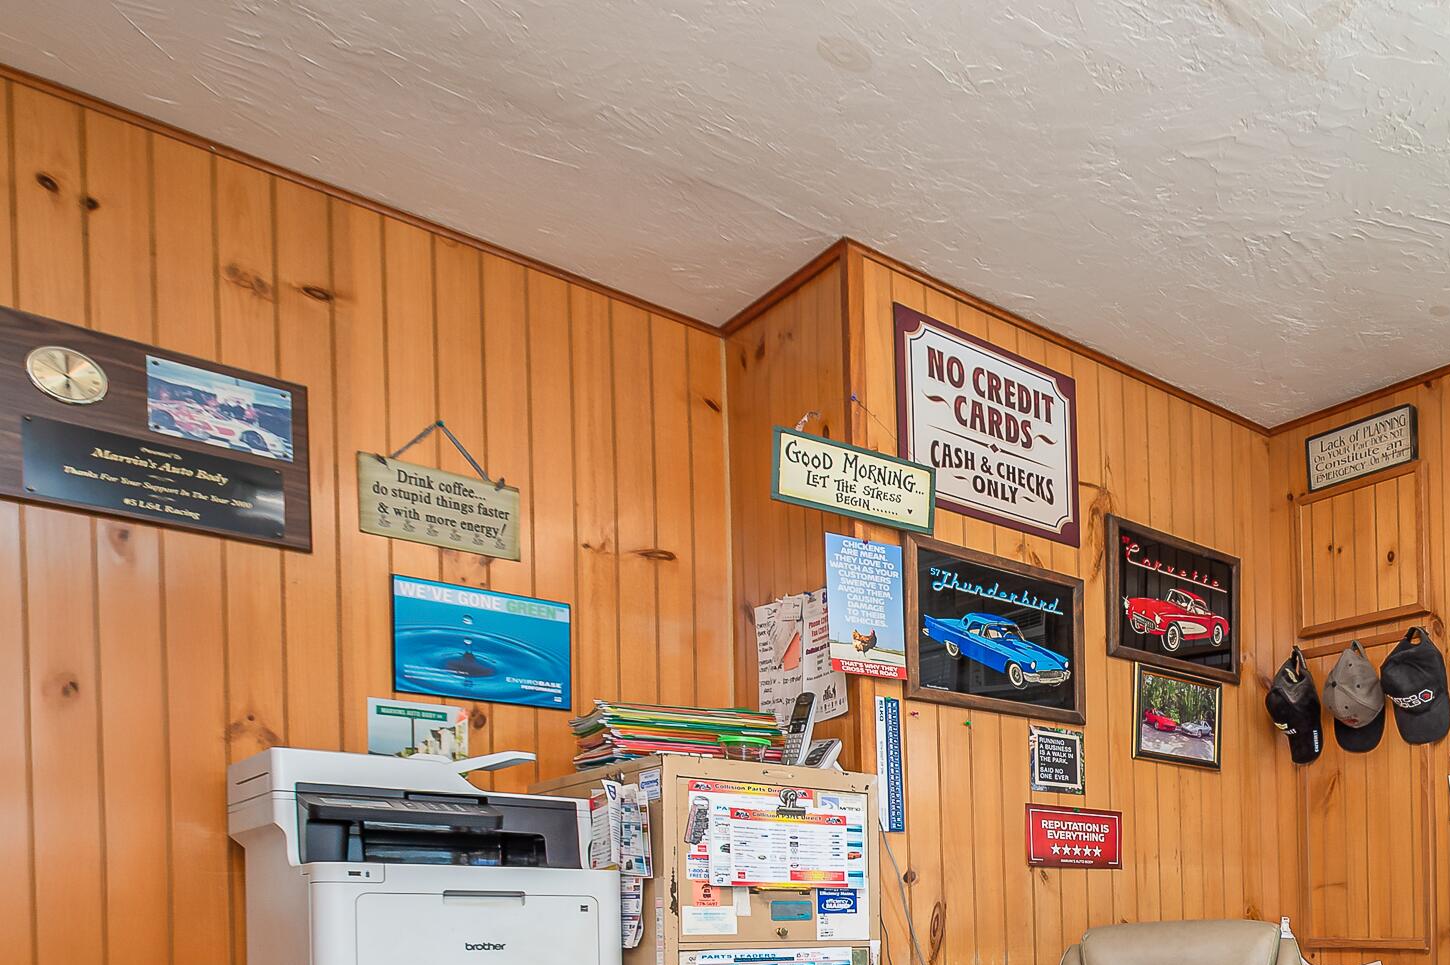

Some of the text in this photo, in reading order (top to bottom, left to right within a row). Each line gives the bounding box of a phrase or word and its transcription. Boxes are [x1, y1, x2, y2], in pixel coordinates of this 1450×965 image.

[926, 346, 1055, 424] NO CREDIT
[954, 396, 1033, 449] CARDS
[1320, 414, 1406, 453] Lack of PLANNING
[785, 440, 833, 470] GOOD
[1314, 455, 1326, 464] On
[1328, 446, 1350, 459] YOUR
[1390, 428, 1403, 440] NOT
[1315, 440, 1402, 472] Constitute an
[91, 448, 228, 486] Marvin's Auto Body
[930, 440, 1054, 506] CASH & CHECKS
[1316, 461, 1366, 484] EMERGENCY
[63, 465, 98, 480] Thanks
[100, 472, 118, 482] For
[120, 476, 141, 487] Your
[142, 481, 178, 496] Support
[191, 490, 208, 501] The
[396, 469, 434, 490] Drink
[806, 470, 902, 504] LET THE STRESS
[972, 475, 1020, 504] ONLY
[372, 482, 510, 521] do stupid things faster
[378, 502, 506, 540] & with more energy!
[841, 548, 888, 562] ARE MEAN.
[842, 540, 886, 554] CHICKENS
[830, 560, 899, 579] WATCH AS YOUR
[834, 554, 894, 570] THEY LOVE TO
[1125, 543, 1228, 594] Corvette
[838, 570, 892, 584] CUSTOMERS
[840, 577, 890, 592] SWERVE TO
[398, 580, 452, 603] WE'VE
[458, 591, 502, 609] GONE
[838, 584, 893, 600] AVOID THEM,
[847, 594, 884, 605] CAUSING
[930, 568, 1064, 615] 57 Thunderbird
[848, 600, 884, 612] DAMAGE
[862, 610, 886, 620] THEIR
[844, 615, 888, 628] VEHICLES.
[840, 660, 866, 668] THAT'S
[882, 664, 898, 672] THEY
[841, 666, 866, 674] CROSS
[1039, 737, 1064, 746] RUNNING
[1045, 744, 1072, 752] BUSINESS
[1042, 820, 1110, 832] REPUTATION IS
[1048, 830, 1104, 842] EVERYTHING
[465, 942, 506, 952] brother
